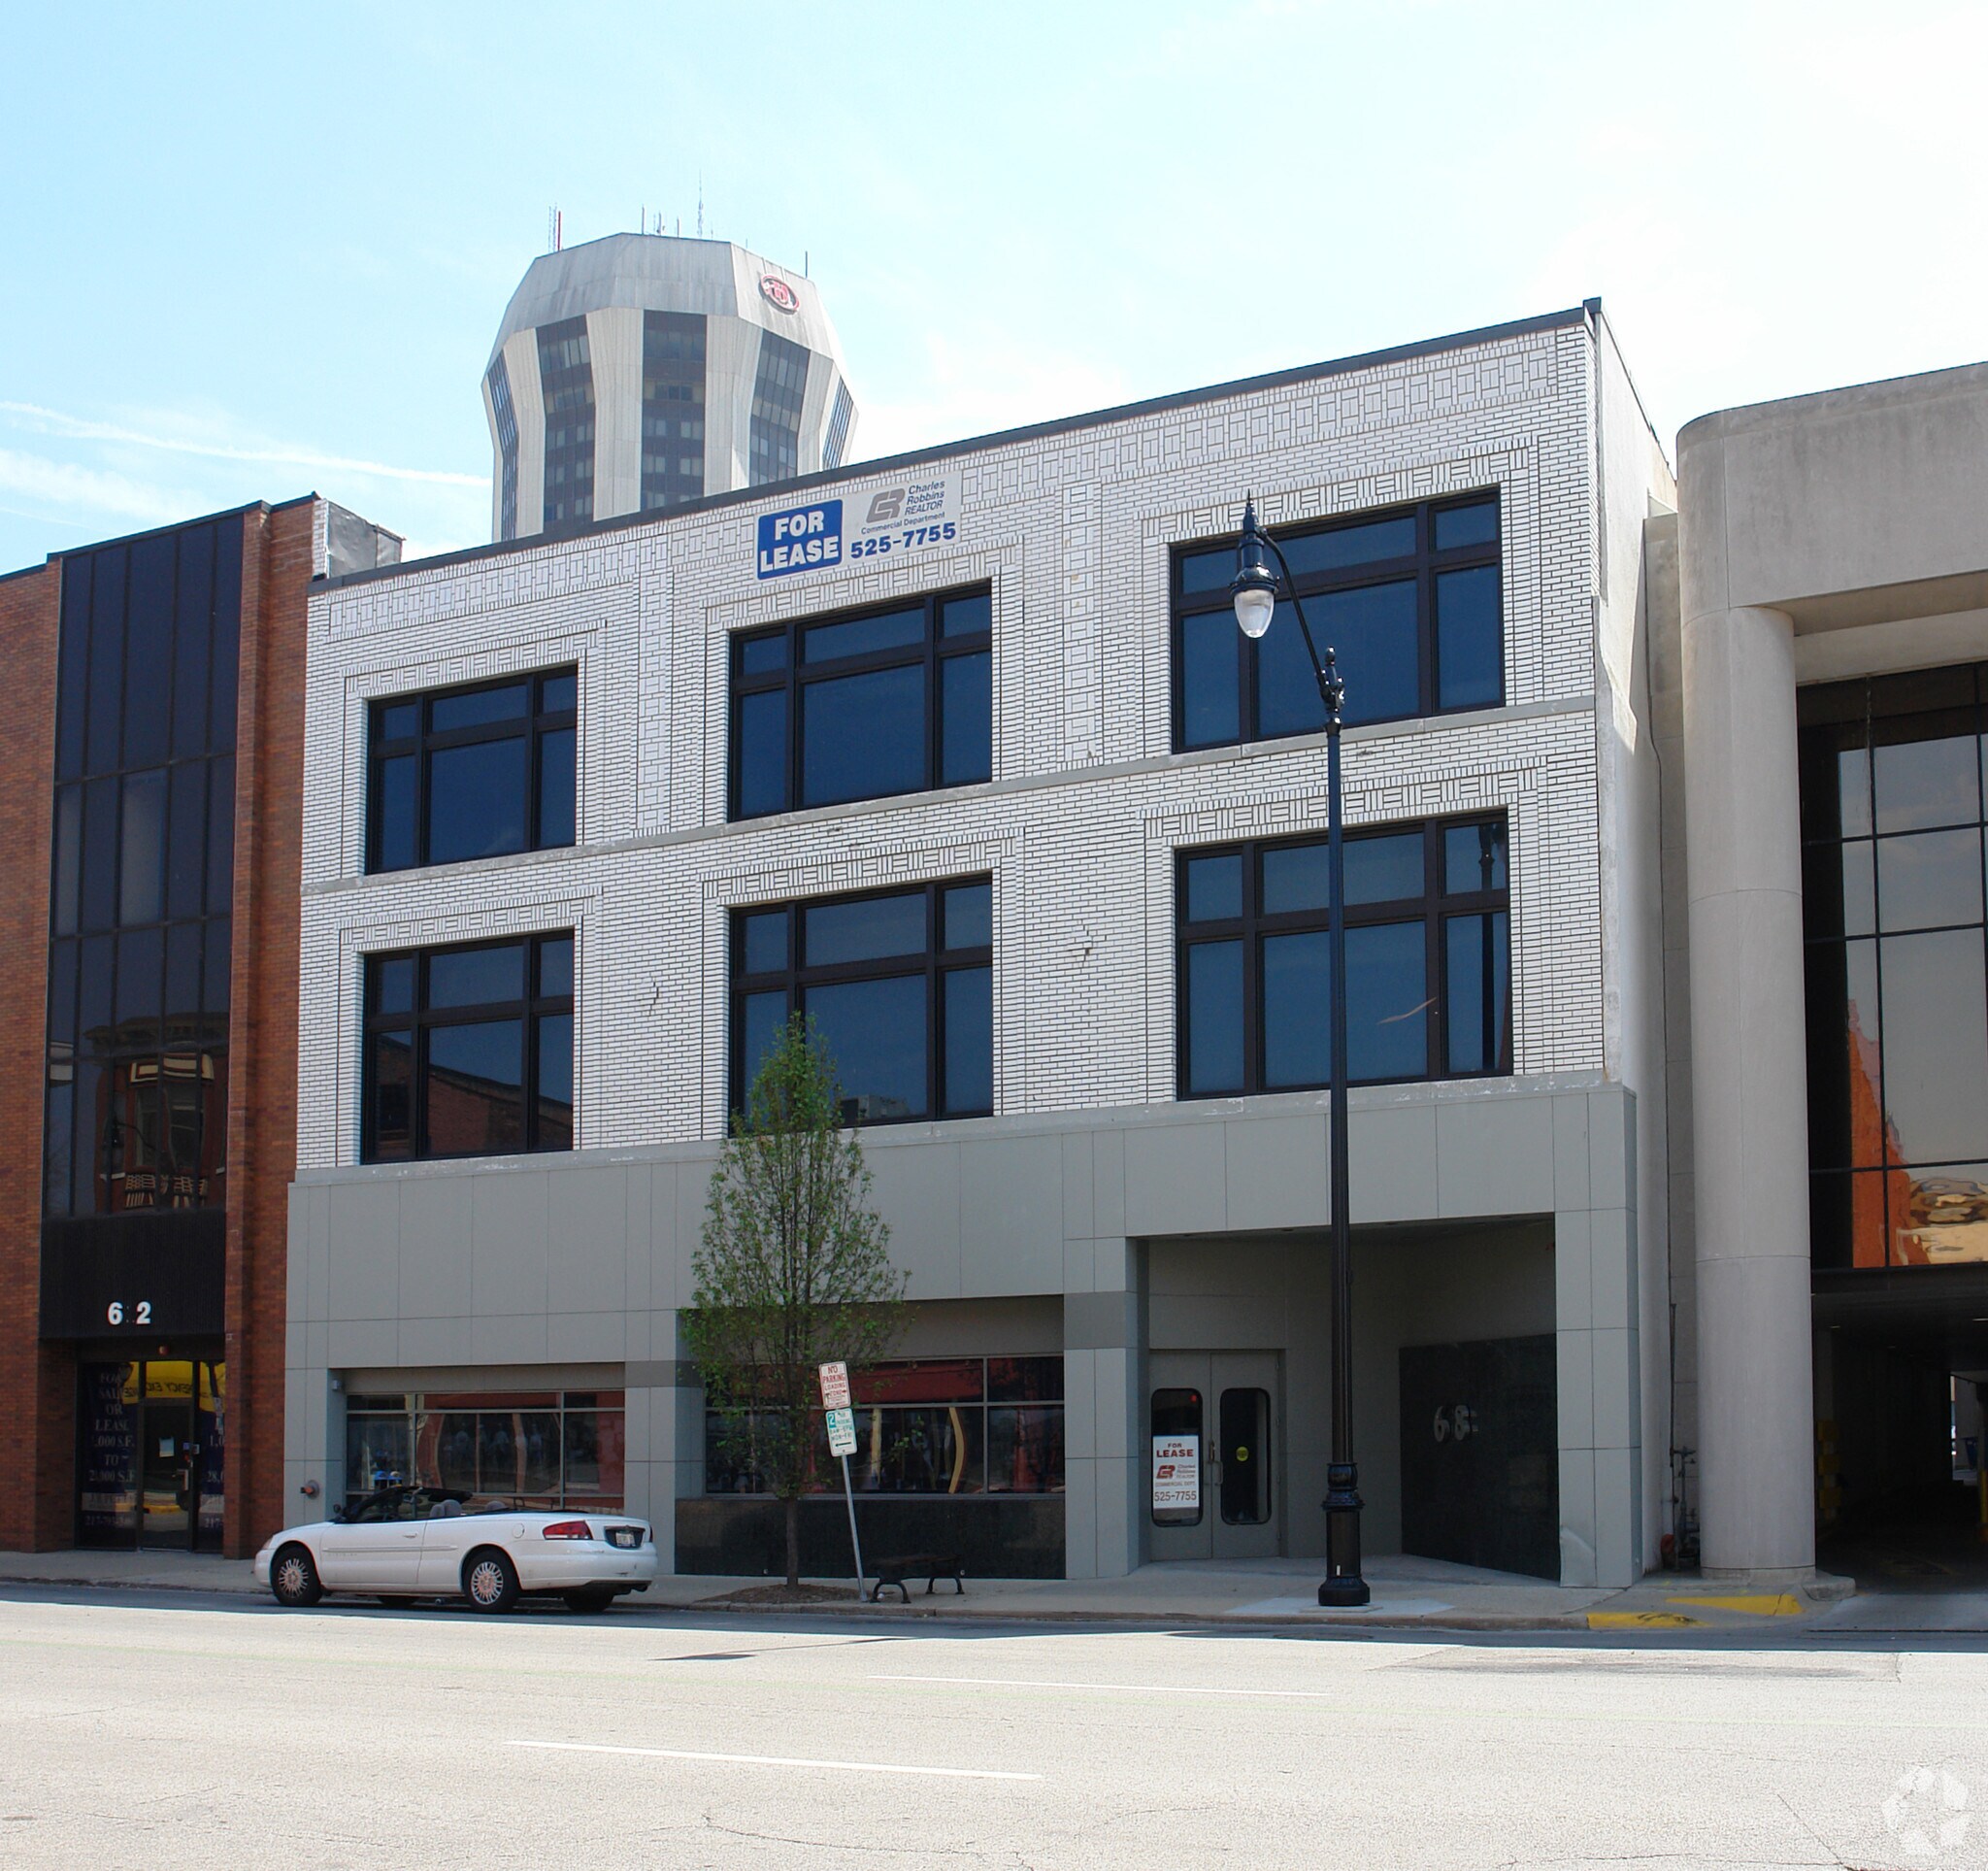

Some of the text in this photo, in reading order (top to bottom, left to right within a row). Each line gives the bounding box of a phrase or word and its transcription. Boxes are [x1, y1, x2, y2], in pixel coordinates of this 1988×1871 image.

[909, 481, 945, 495] Charles
[907, 490, 944, 506] Robbins
[904, 499, 944, 516] REALTOR
[775, 510, 824, 541] FOR
[861, 512, 945, 535] Commercial Department
[850, 521, 956, 559] 525-7755
[760, 536, 840, 573] LEASE
[827, 1365, 839, 1374] NO
[1156, 1449, 1194, 1458] LEASE
[1154, 1490, 1197, 1502] 525-7755
